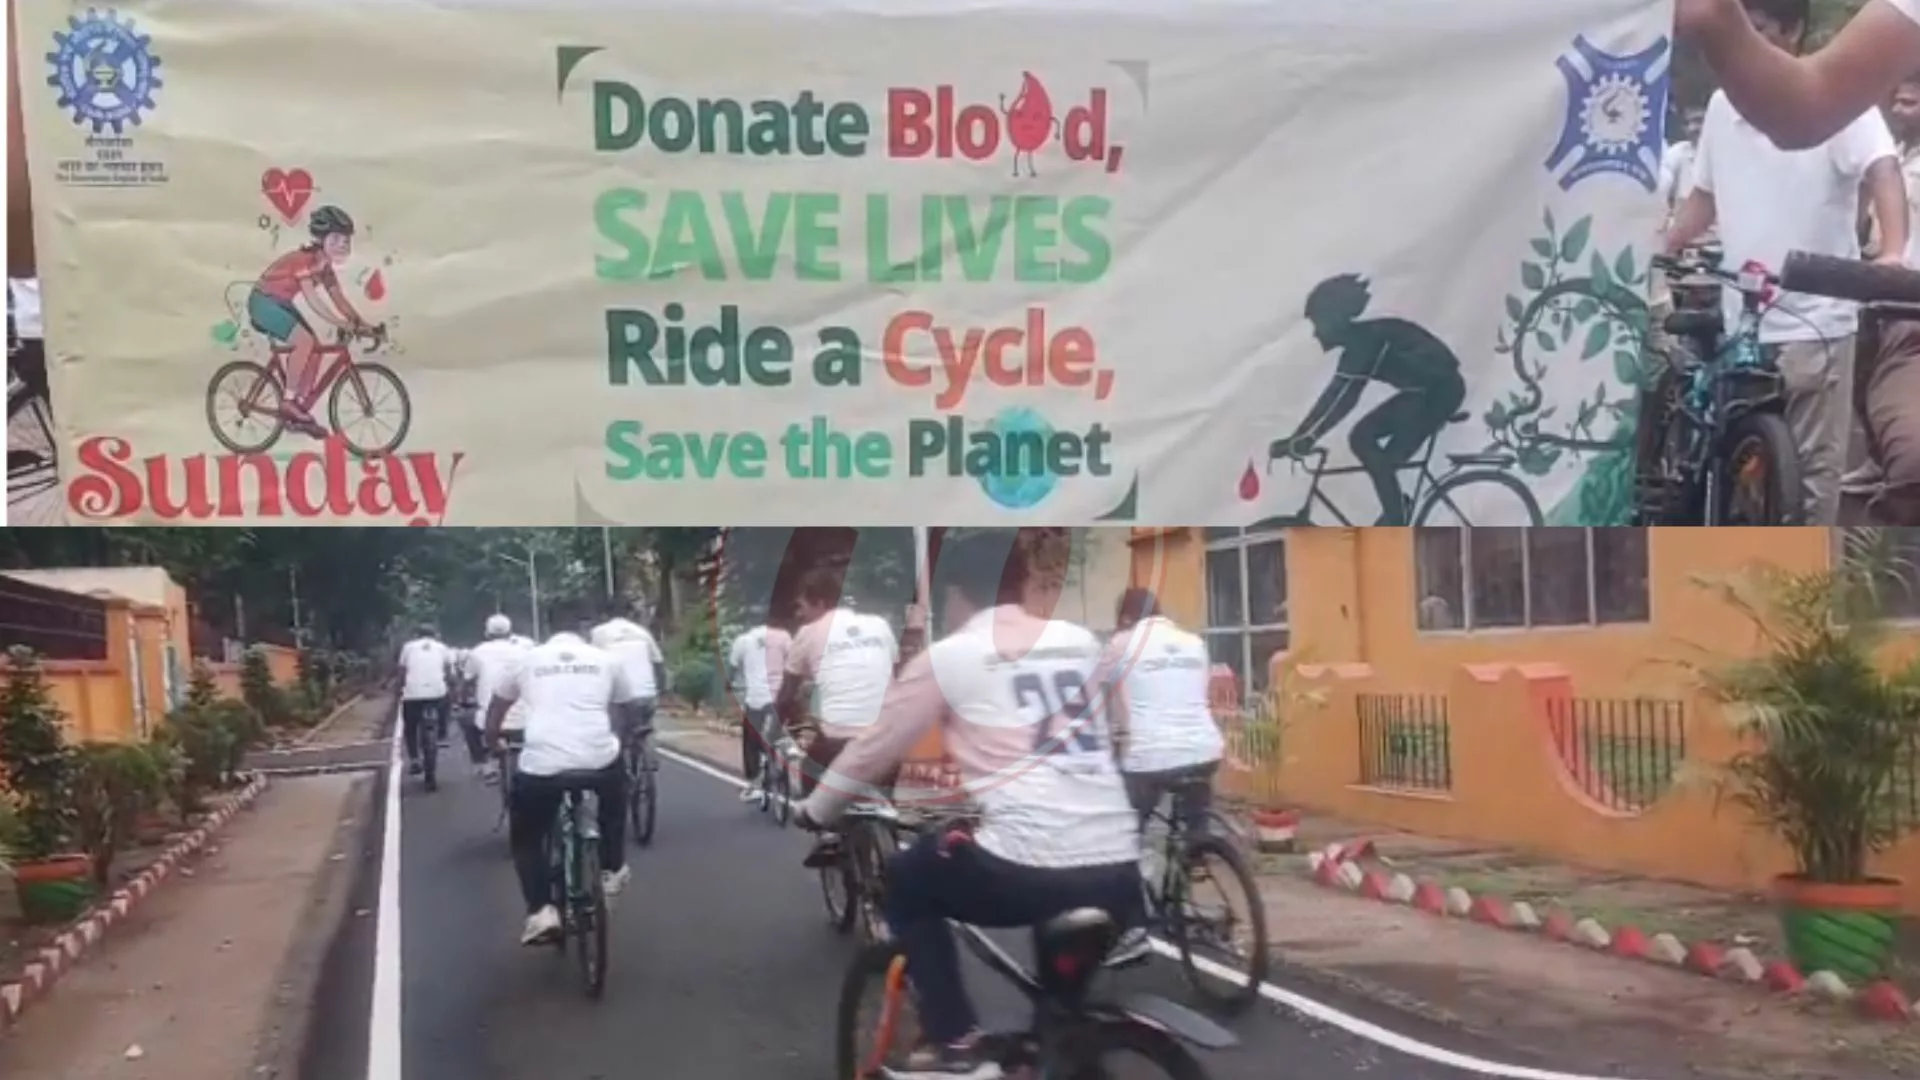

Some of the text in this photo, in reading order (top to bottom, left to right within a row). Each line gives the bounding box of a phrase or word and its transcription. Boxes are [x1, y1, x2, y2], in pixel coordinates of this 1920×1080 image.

[593, 81, 869, 156] Donate
[592, 188, 1112, 282] SAVE LIVES
[605, 303, 1115, 409] Ride a Cycle,
[68, 434, 465, 526] Sunday
[604, 415, 1112, 480] Save the Planet
